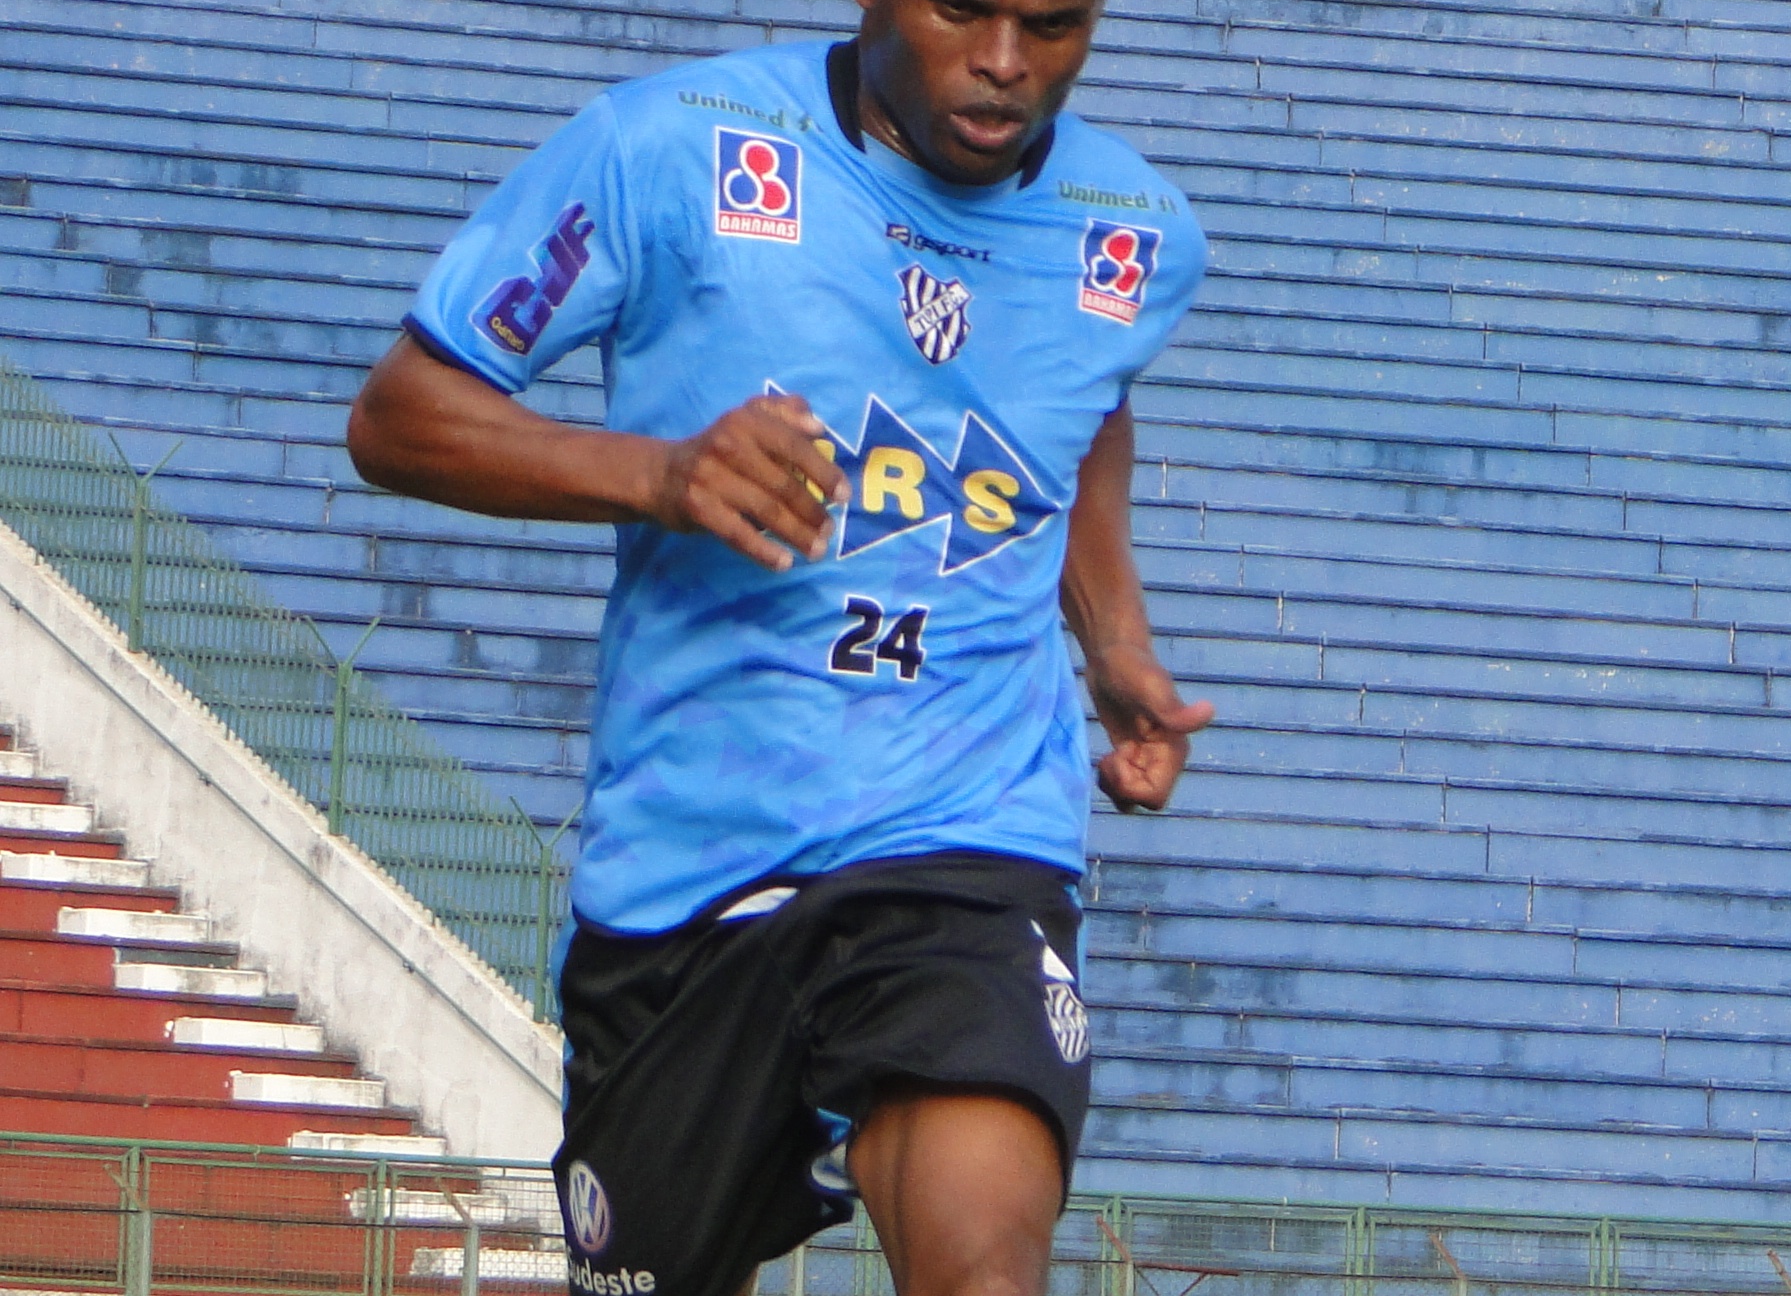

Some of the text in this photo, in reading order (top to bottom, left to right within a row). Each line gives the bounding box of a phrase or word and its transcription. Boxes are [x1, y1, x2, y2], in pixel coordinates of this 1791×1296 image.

[678, 91, 785, 128] Unimed
[1058, 180, 1150, 209] Unimed
[720, 214, 796, 237] BAHAMAS
[469, 200, 595, 356] CJF
[828, 593, 930, 682] 24
